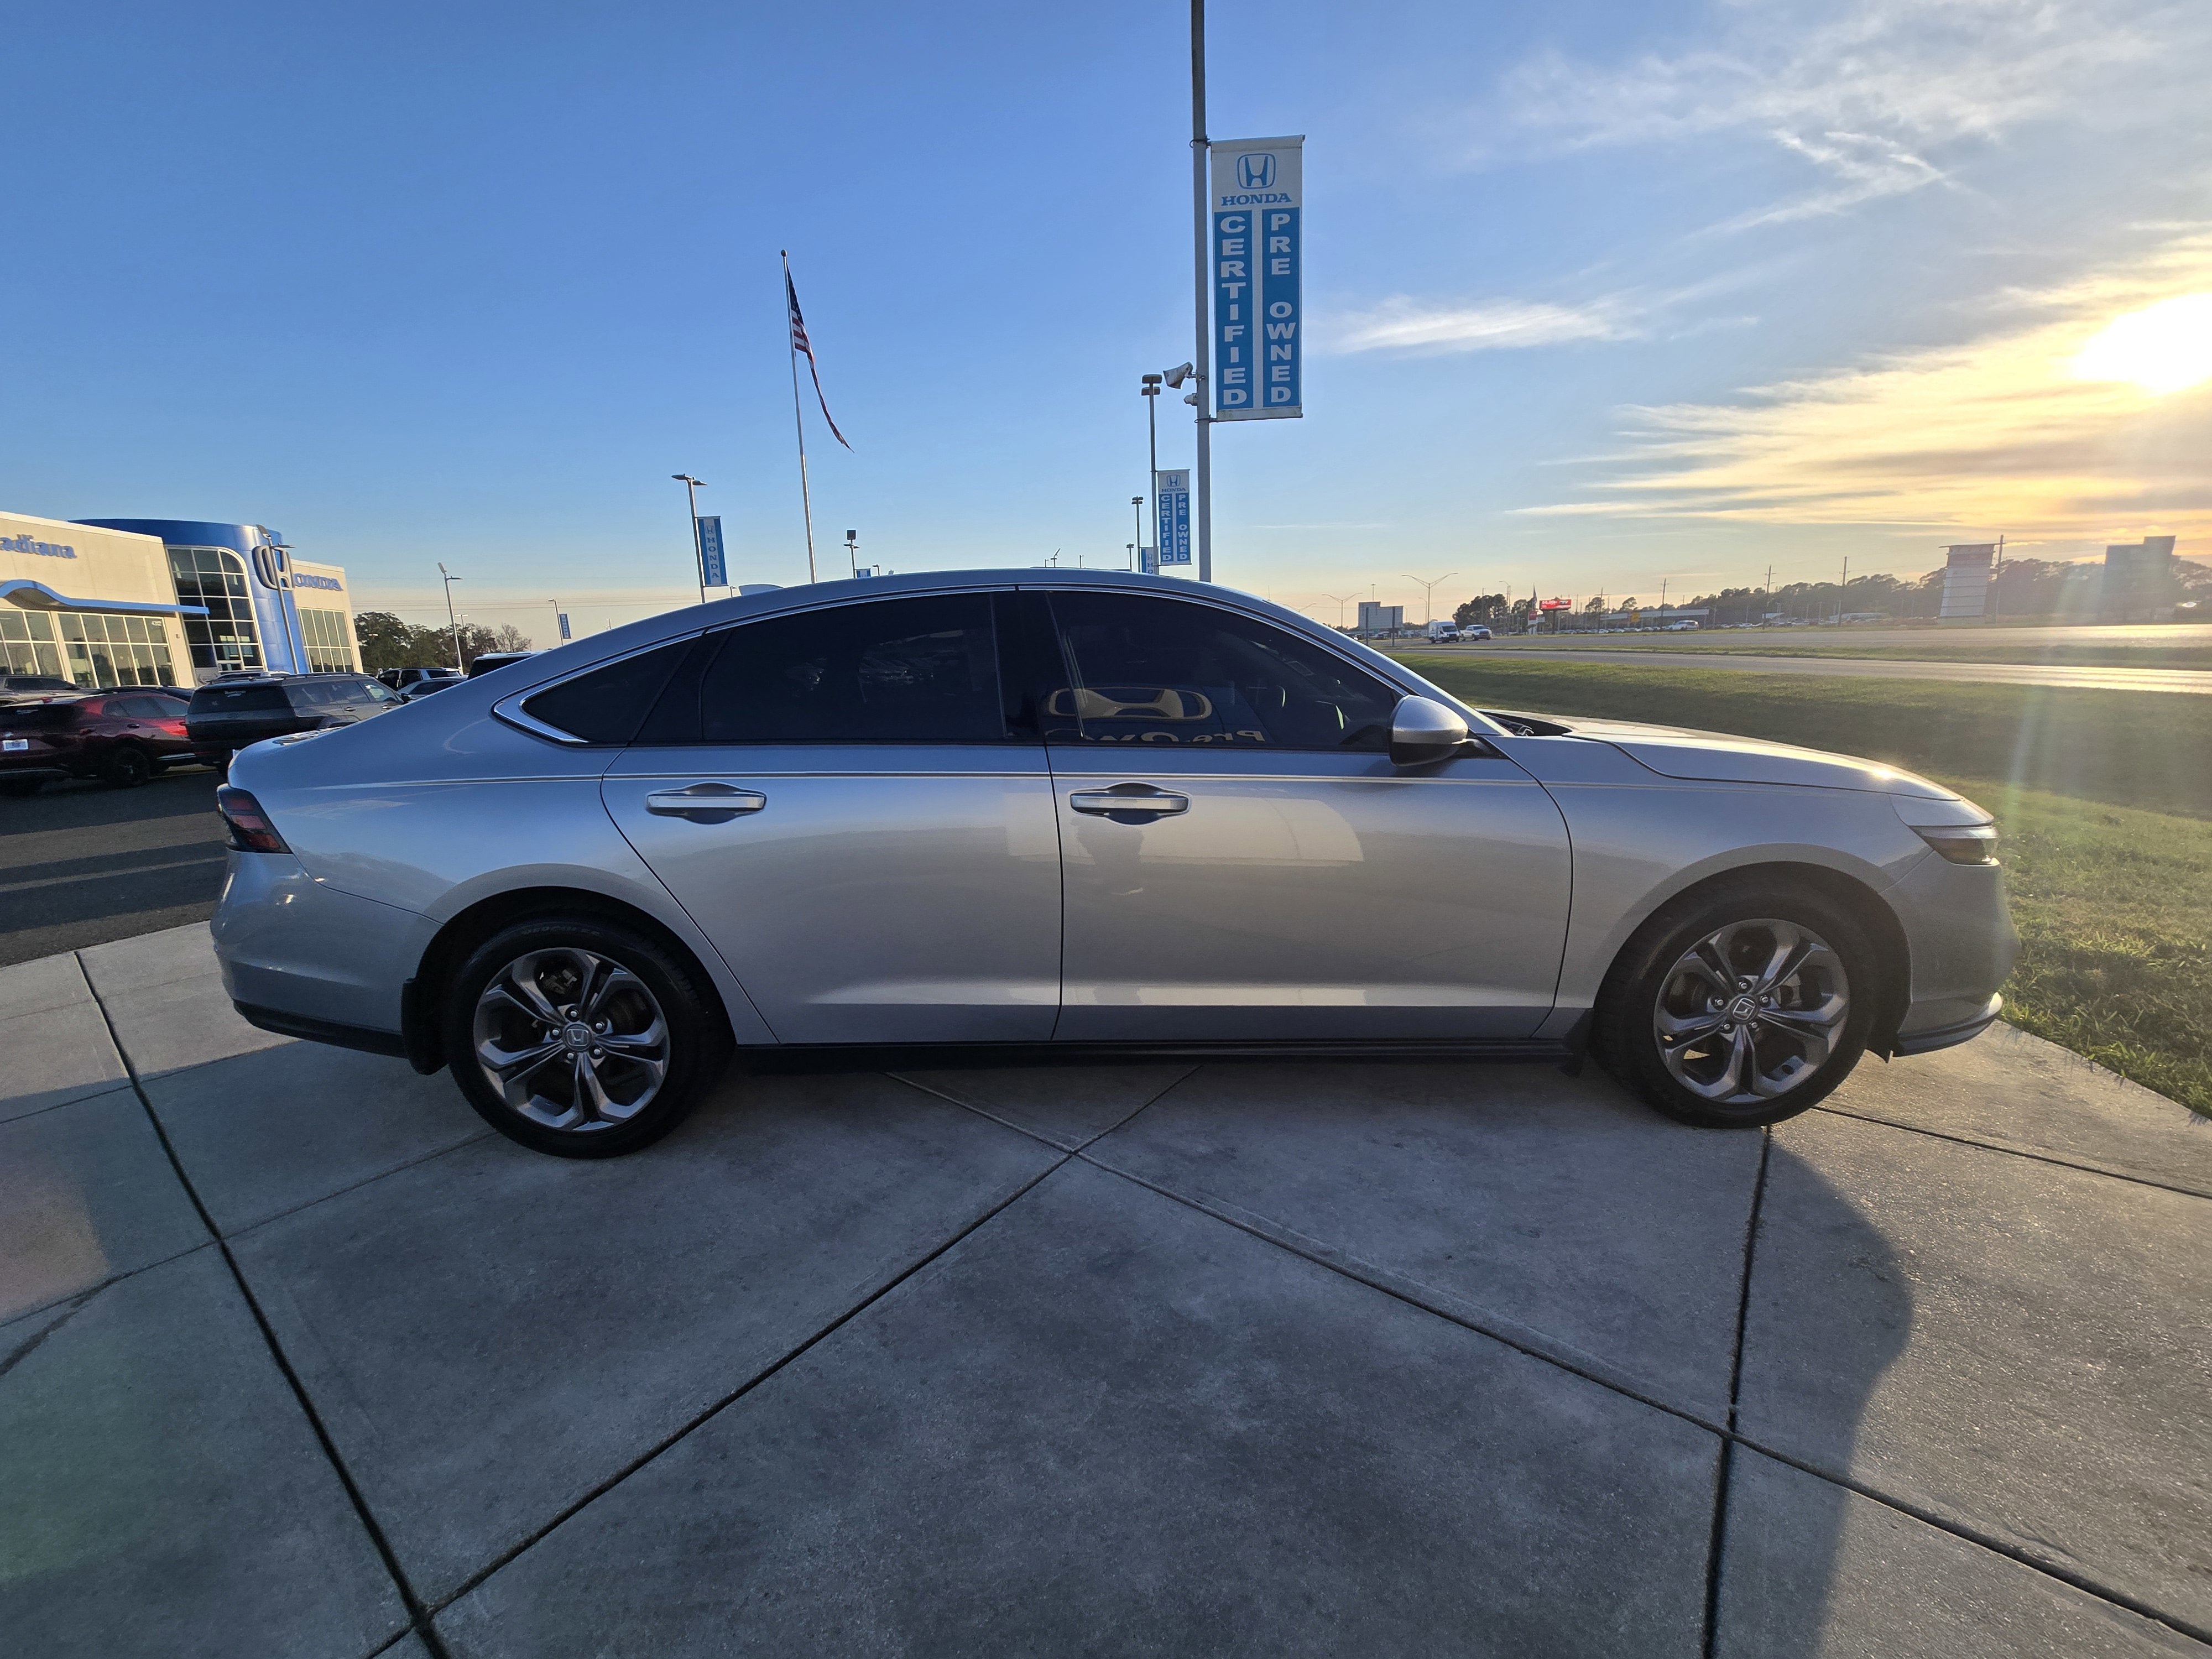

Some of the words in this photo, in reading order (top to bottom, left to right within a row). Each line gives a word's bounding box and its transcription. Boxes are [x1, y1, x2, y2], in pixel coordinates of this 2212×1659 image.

[1220, 192, 1292, 206] HONDA
[1270, 213, 1291, 276] PRE
[1220, 215, 1248, 405] CERTIFIED
[1266, 301, 1296, 403] OWNED
[1161, 495, 1172, 561] CERTIFIED
[1178, 524, 1188, 560] OWNED
[294, 573, 344, 591] ONDA
[707, 537, 719, 578] HONDA
